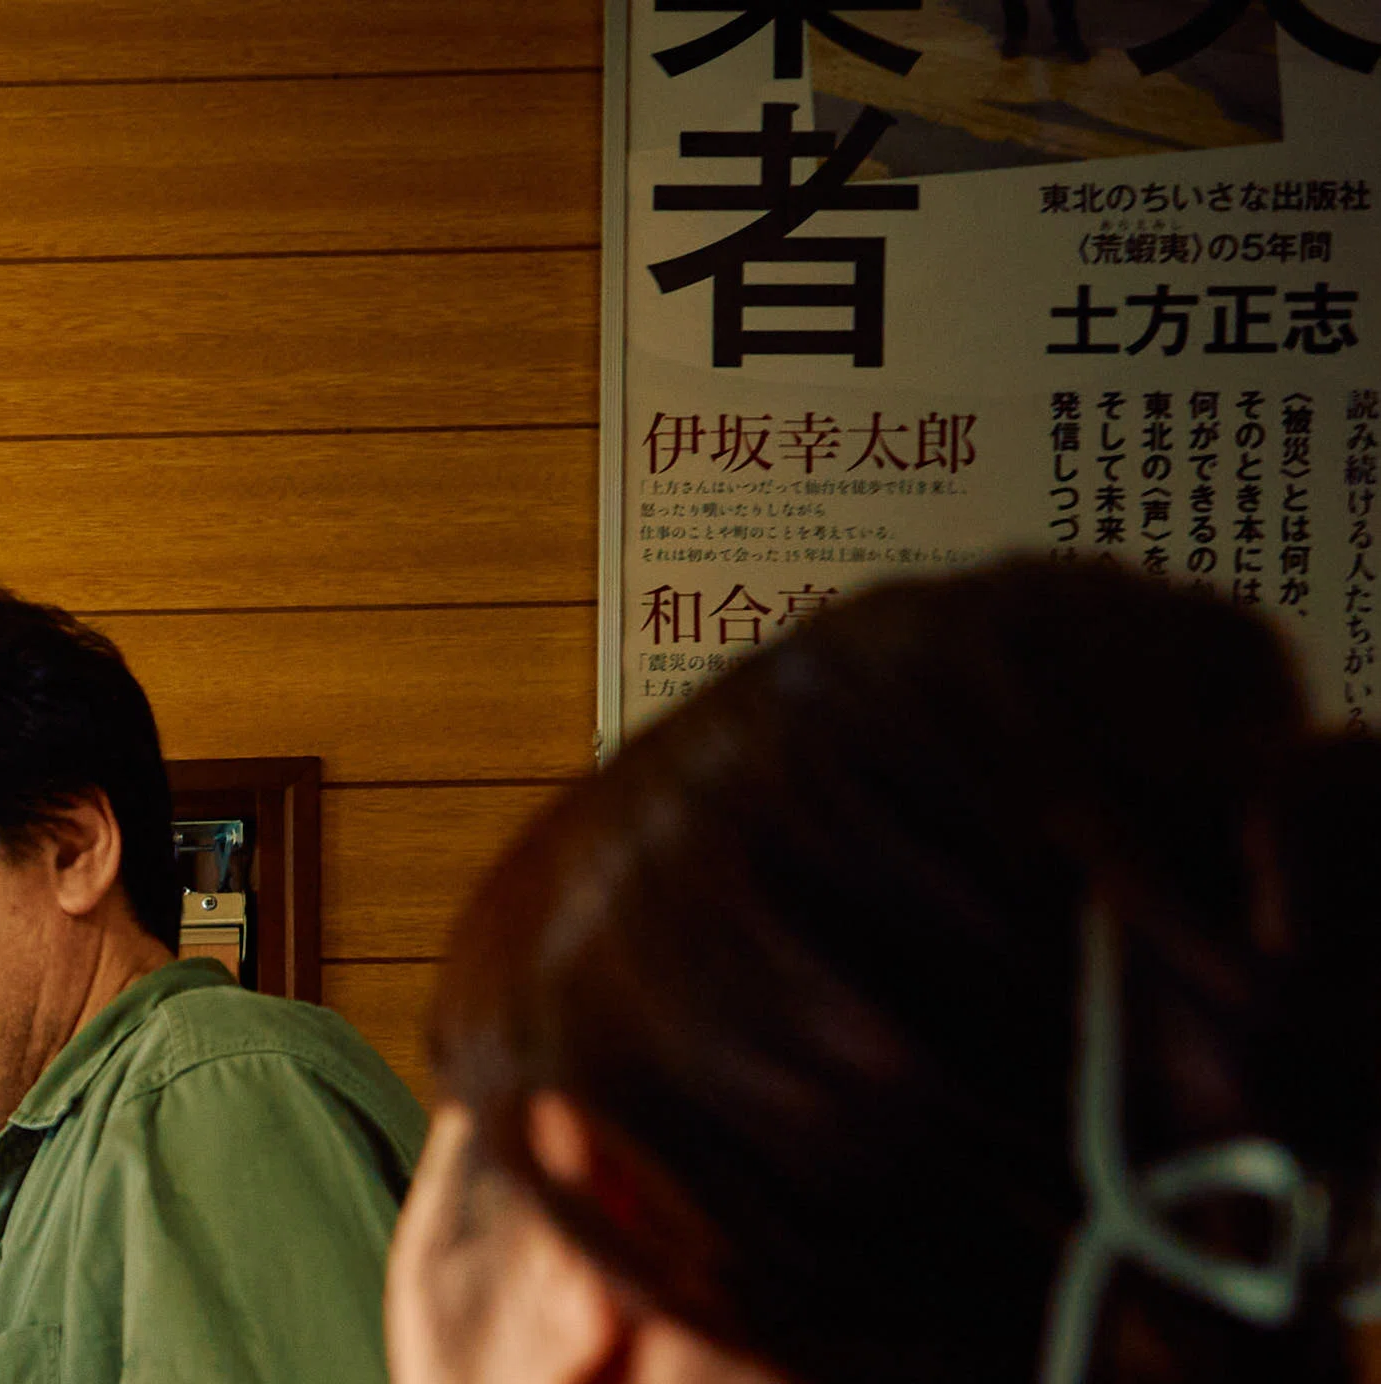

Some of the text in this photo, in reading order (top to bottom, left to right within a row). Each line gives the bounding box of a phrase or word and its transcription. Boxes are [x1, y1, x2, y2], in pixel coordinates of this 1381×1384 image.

[1040, 180, 1372, 214] 東北のちいさな出版社
[1046, 282, 1359, 356] 土方正志
[641, 411, 977, 475] 伊坂幸太郎
